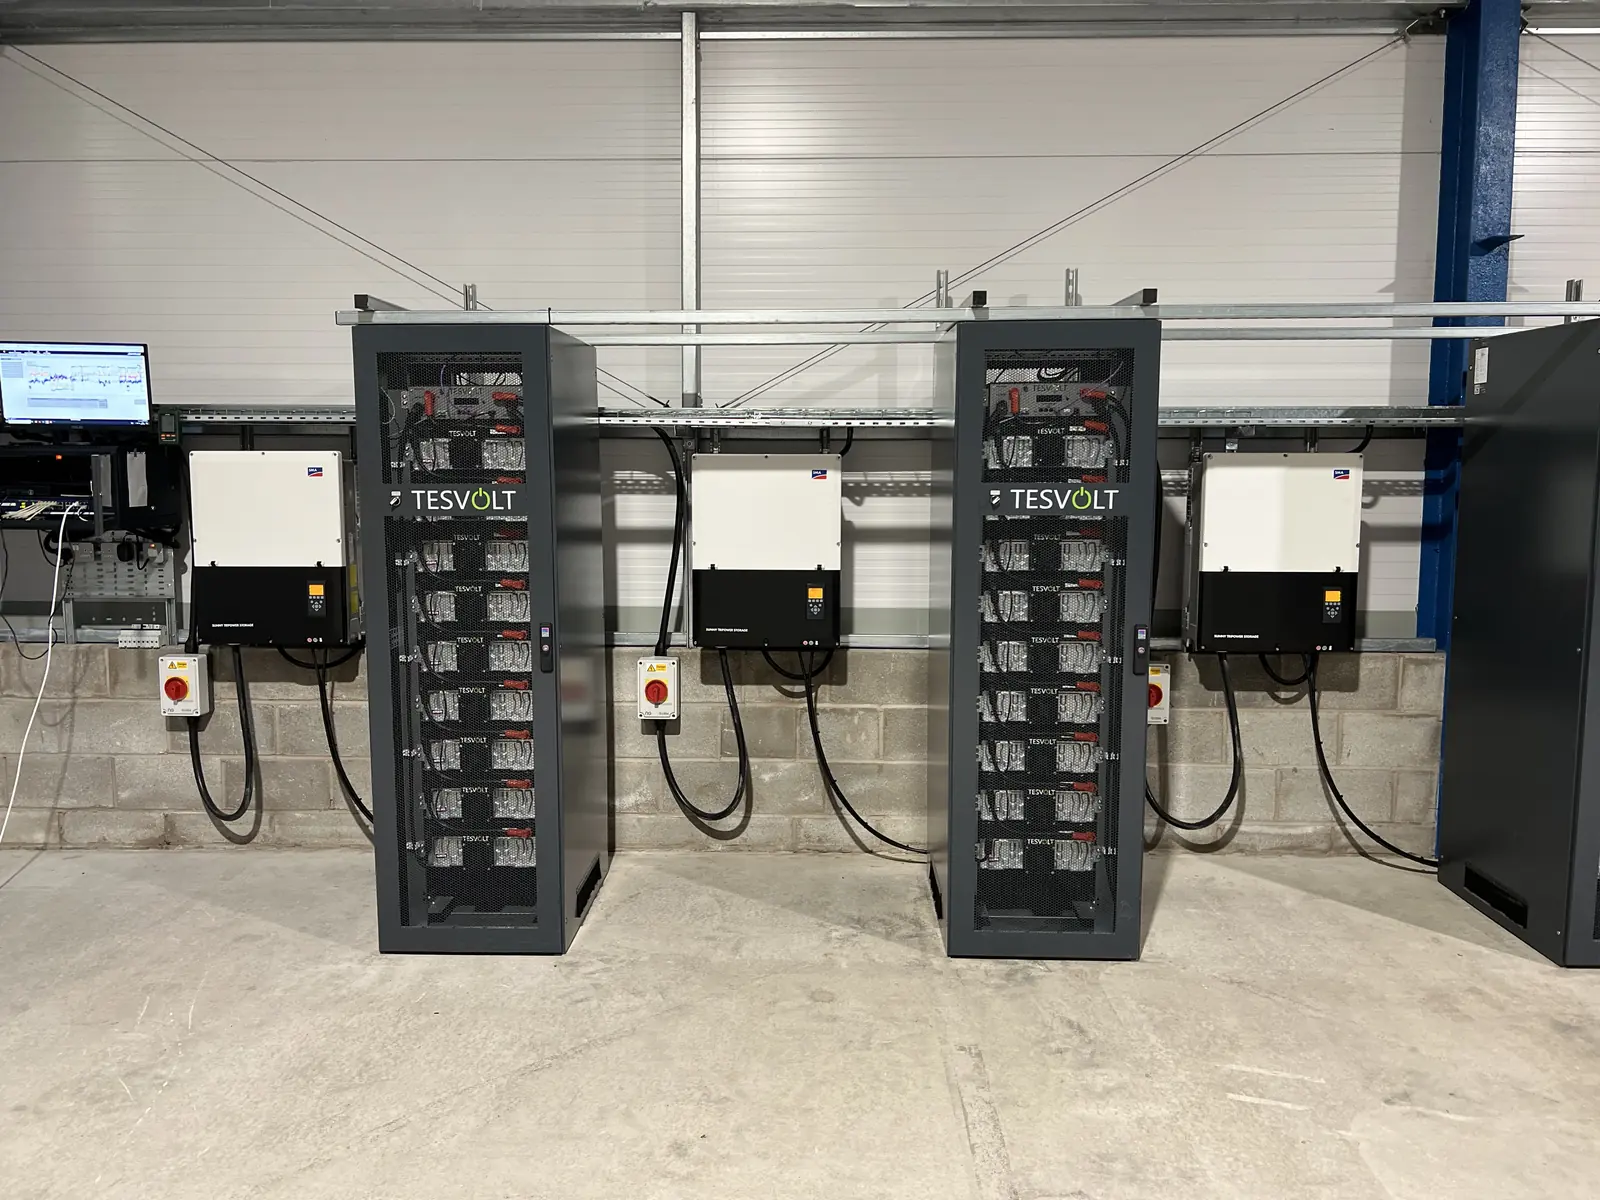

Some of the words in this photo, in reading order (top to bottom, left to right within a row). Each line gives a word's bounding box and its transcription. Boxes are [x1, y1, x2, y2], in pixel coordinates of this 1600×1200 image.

[411, 488, 516, 510] TESVOLT
[1011, 487, 1119, 510] TESVOLT
[1032, 636, 1059, 644] TESVOLT
[1031, 687, 1058, 695] TESVOLT
